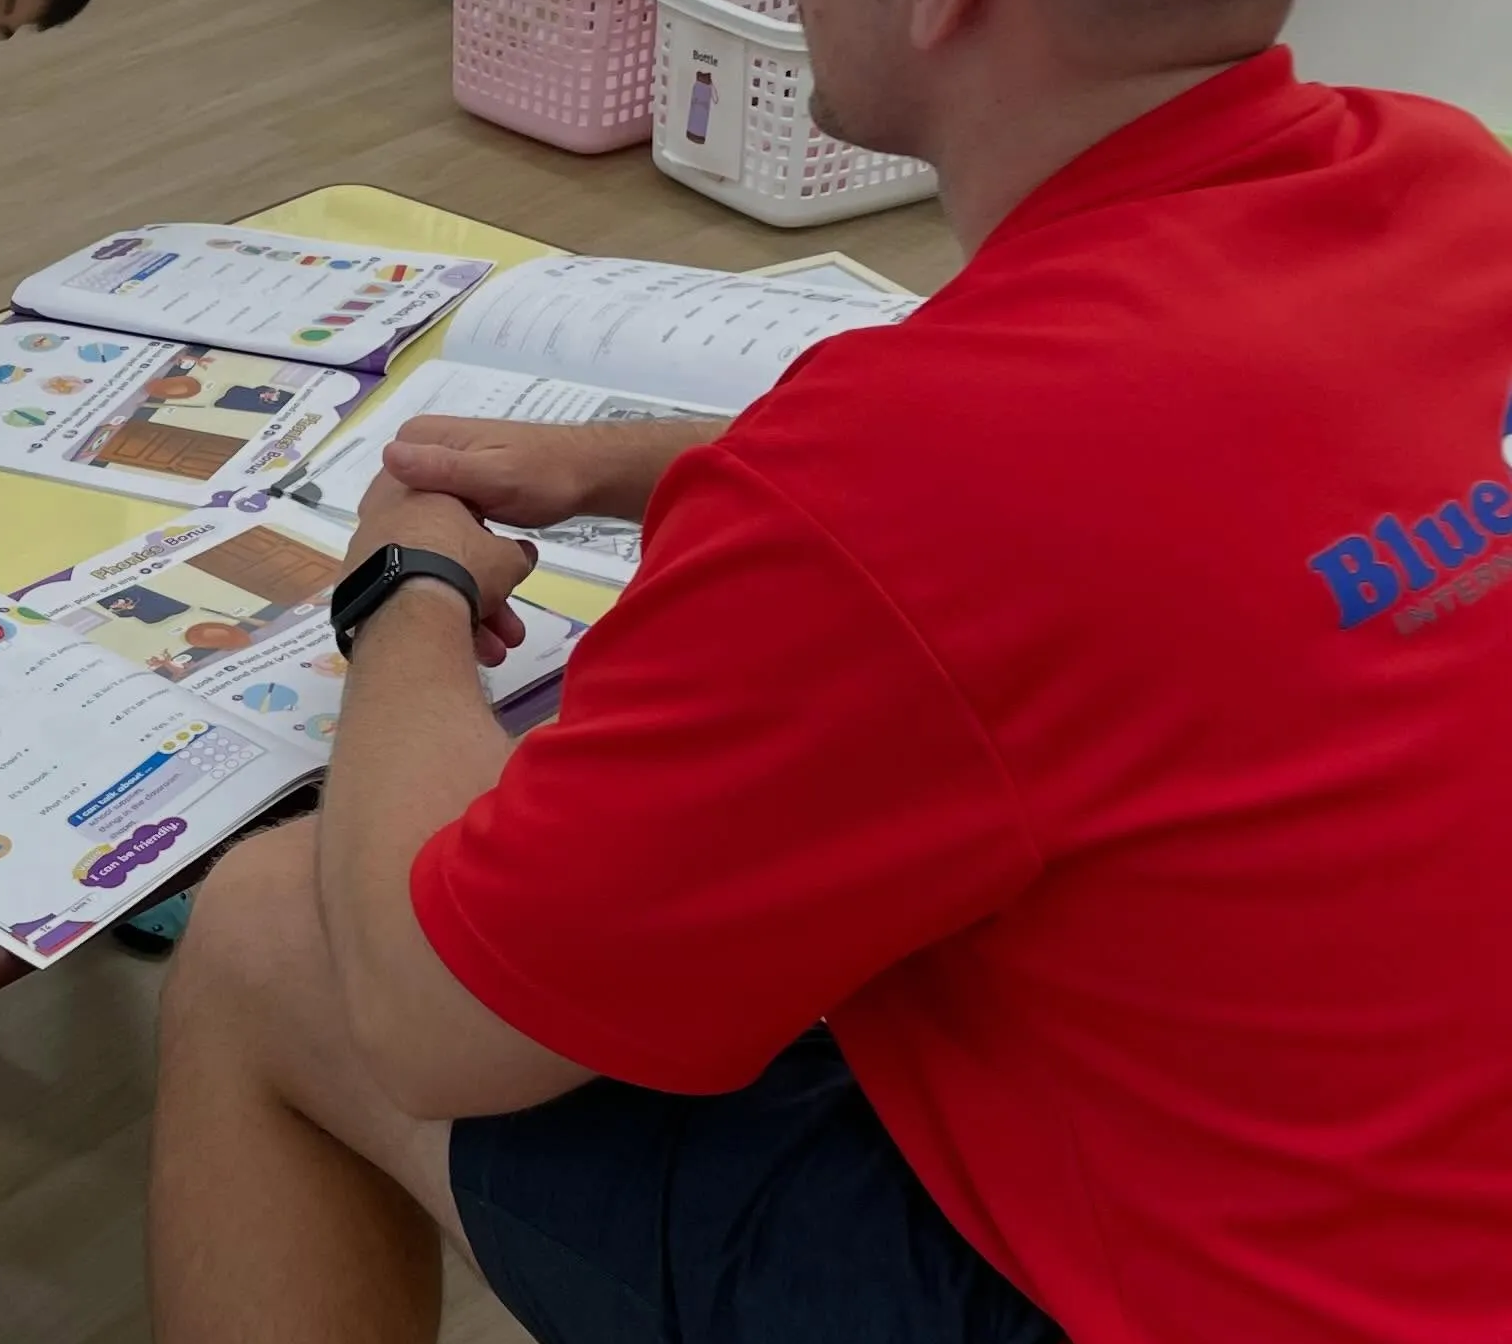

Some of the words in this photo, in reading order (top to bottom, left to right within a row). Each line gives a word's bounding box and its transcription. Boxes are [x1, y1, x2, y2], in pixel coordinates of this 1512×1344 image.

[693, 49, 719, 67] Bottle
[245, 451, 281, 475] Bonus
[90, 544, 164, 580] Phonics
[164, 522, 215, 547] Bonus
[1306, 480, 1512, 631] Blue
[82, 804, 100, 817] can
[98, 790, 118, 806] talk
[117, 771, 144, 793] about
[99, 860, 120, 877] can
[117, 849, 135, 863] be
[133, 822, 180, 853] friendly.
